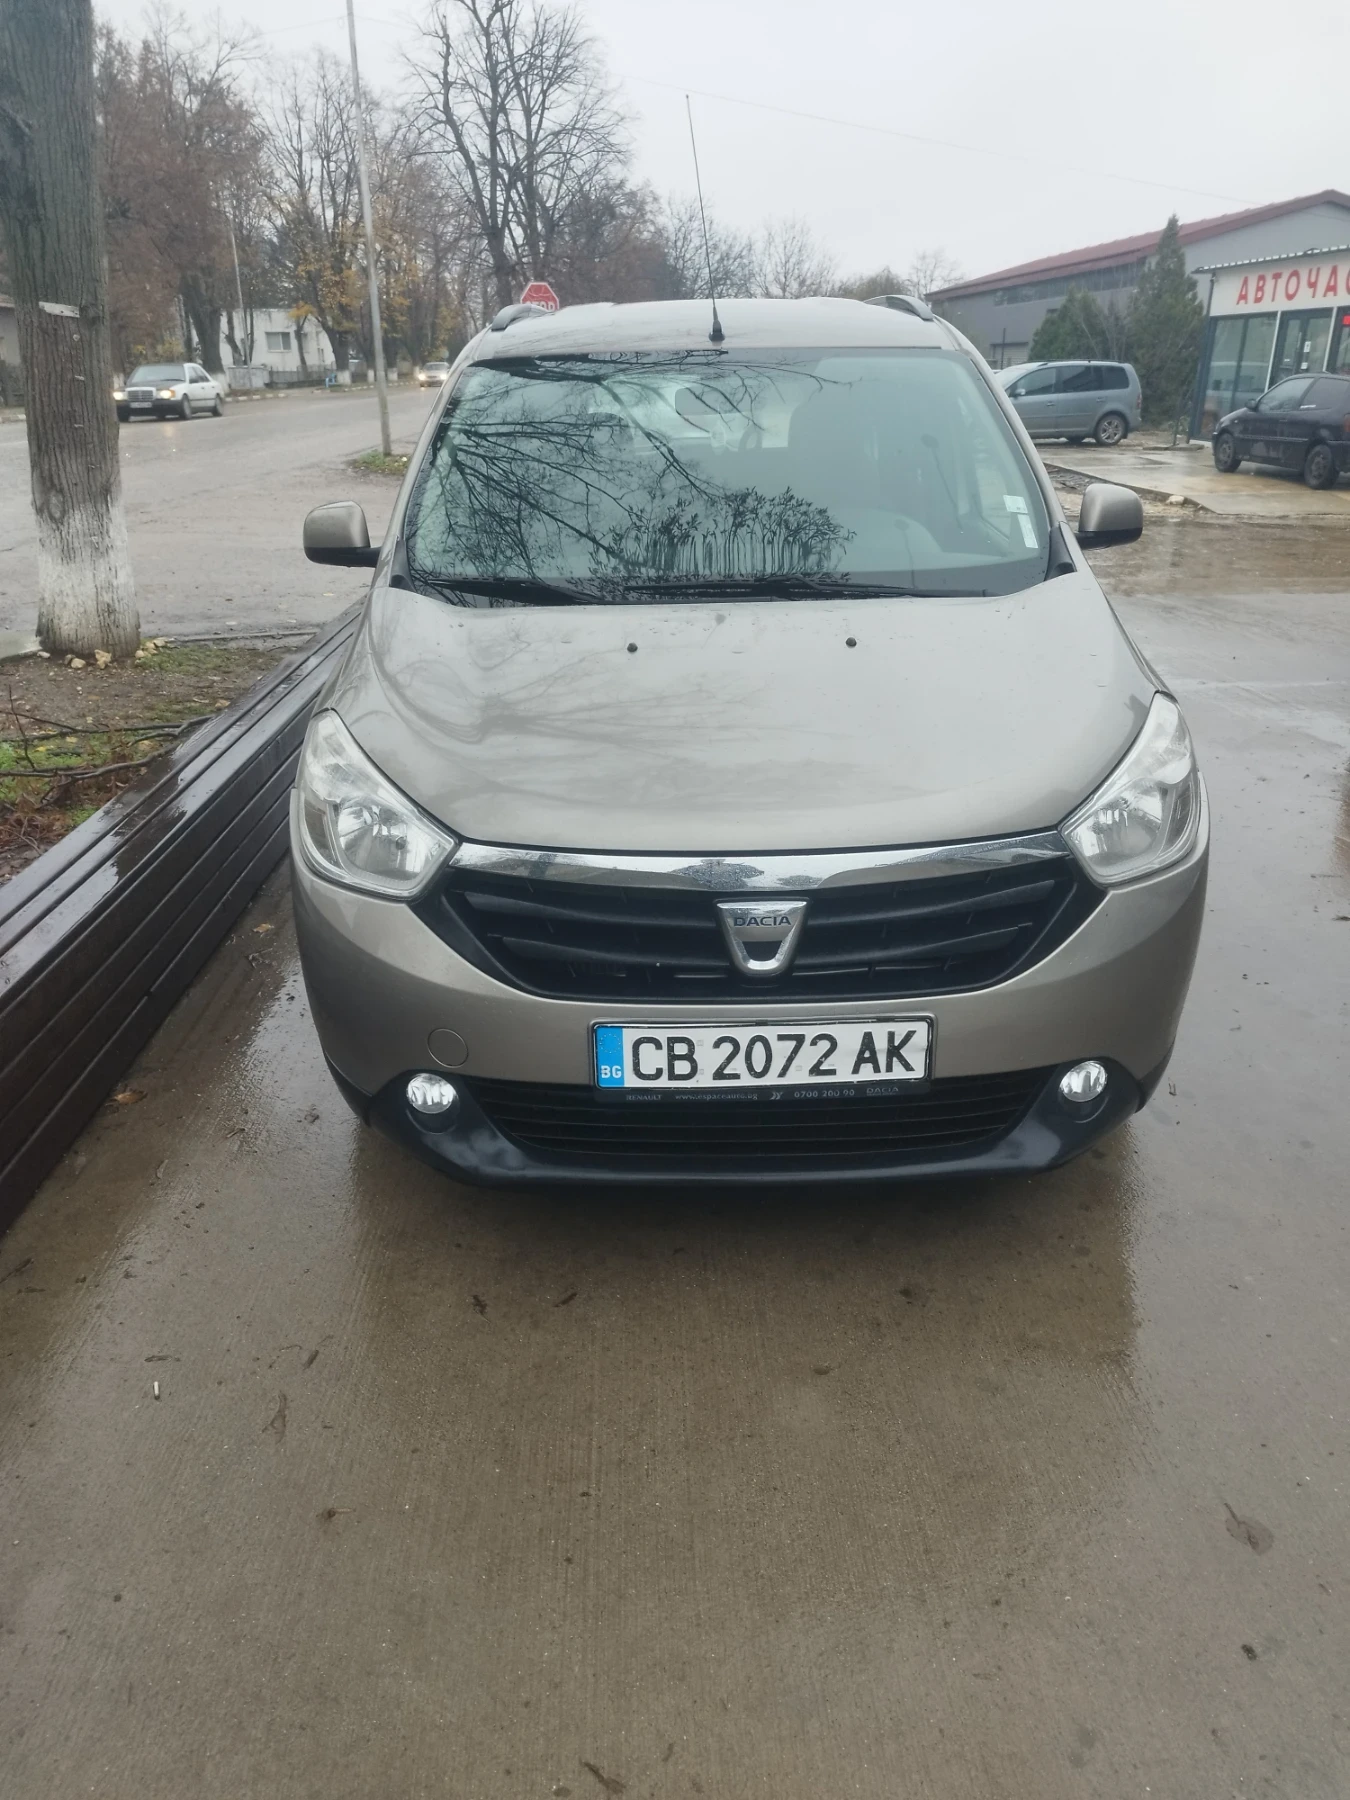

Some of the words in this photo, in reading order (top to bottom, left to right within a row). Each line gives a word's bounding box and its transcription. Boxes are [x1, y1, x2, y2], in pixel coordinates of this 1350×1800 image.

[733, 915, 791, 927] DACIA
[631, 1036, 698, 1081] CB
[712, 1033, 838, 1081] 2072
[850, 1030, 917, 1075] AK
[600, 1065, 622, 1079] BG
[866, 1086, 899, 1094] DACIA
